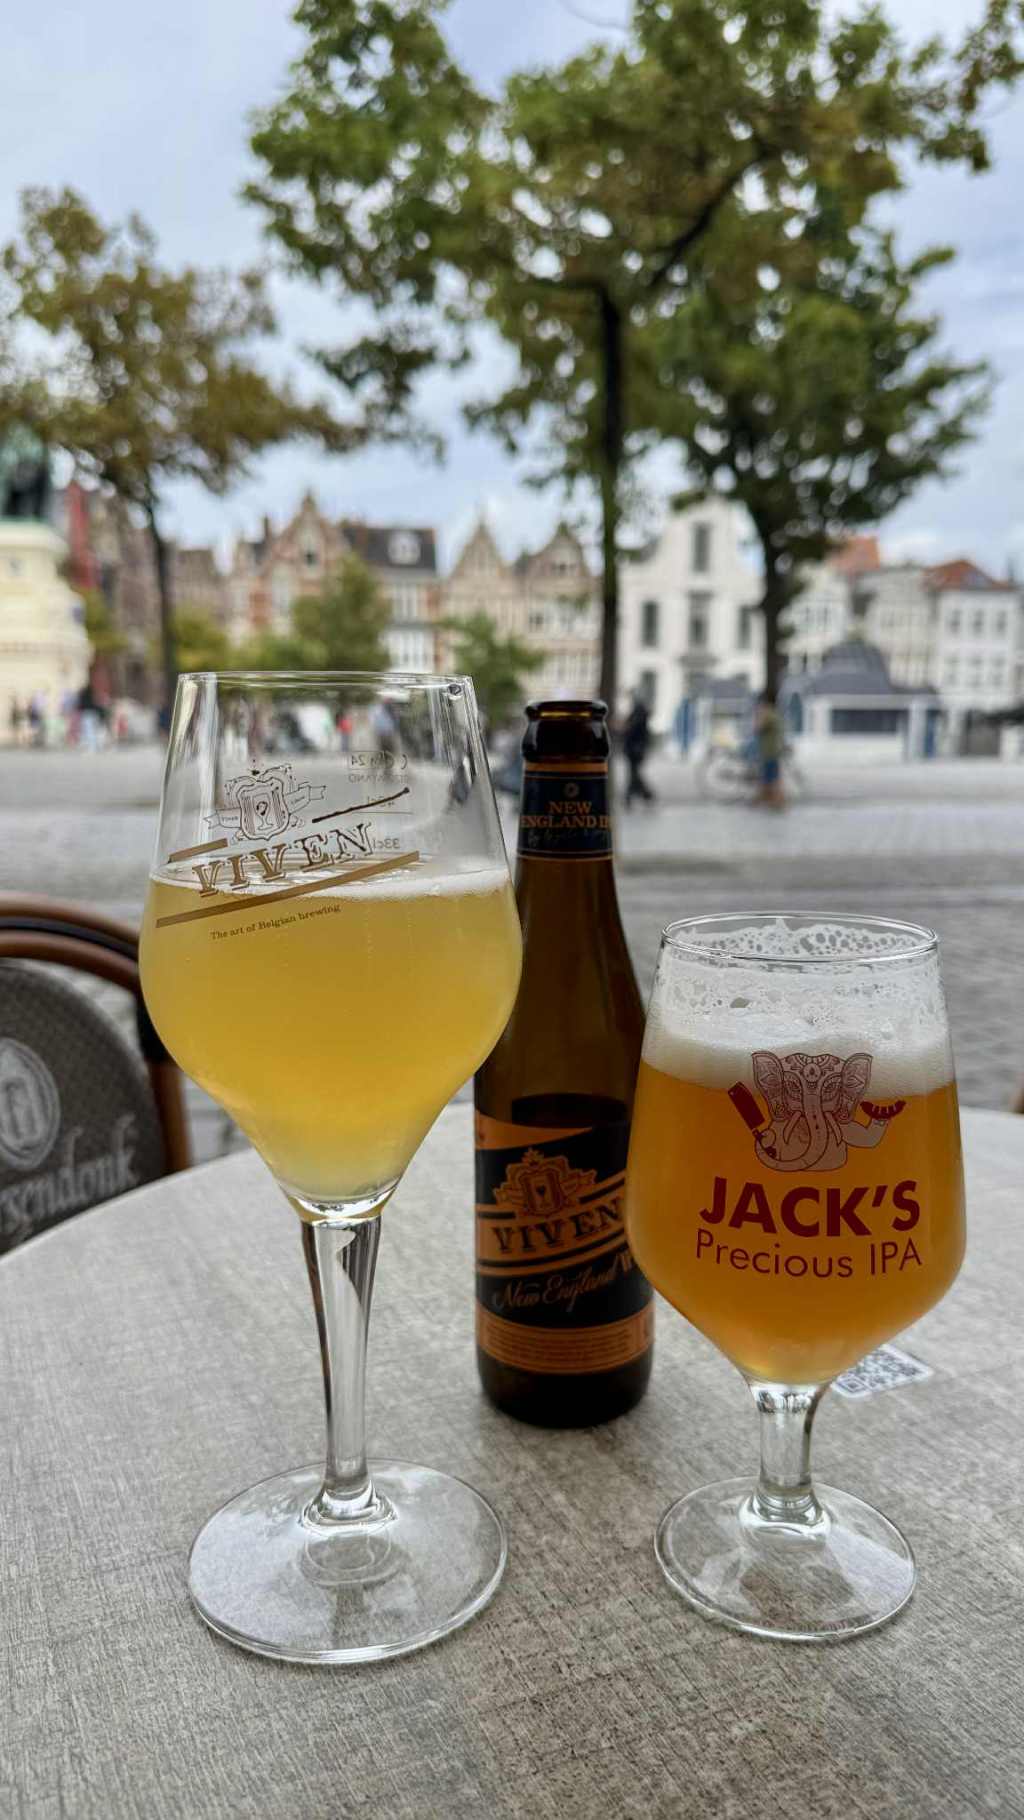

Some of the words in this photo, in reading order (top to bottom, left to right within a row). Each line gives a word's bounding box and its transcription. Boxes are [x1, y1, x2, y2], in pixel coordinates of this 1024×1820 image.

[520, 815, 598, 829] ENGLAND
[548, 800, 593, 815] NEW
[191, 821, 374, 897] VIVEN
[210, 931, 228, 941] The
[229, 927, 245, 937] art
[246, 923, 256, 934] of
[257, 915, 297, 931] Belgian
[298, 904, 342, 921] brewing
[491, 1196, 626, 1254] VIVEN
[698, 1175, 921, 1238] JACK'S
[696, 1227, 854, 1279] Precious
[869, 1237, 923, 1276] IPA
[491, 1278, 542, 1311] New
[542, 1253, 619, 1312] England
